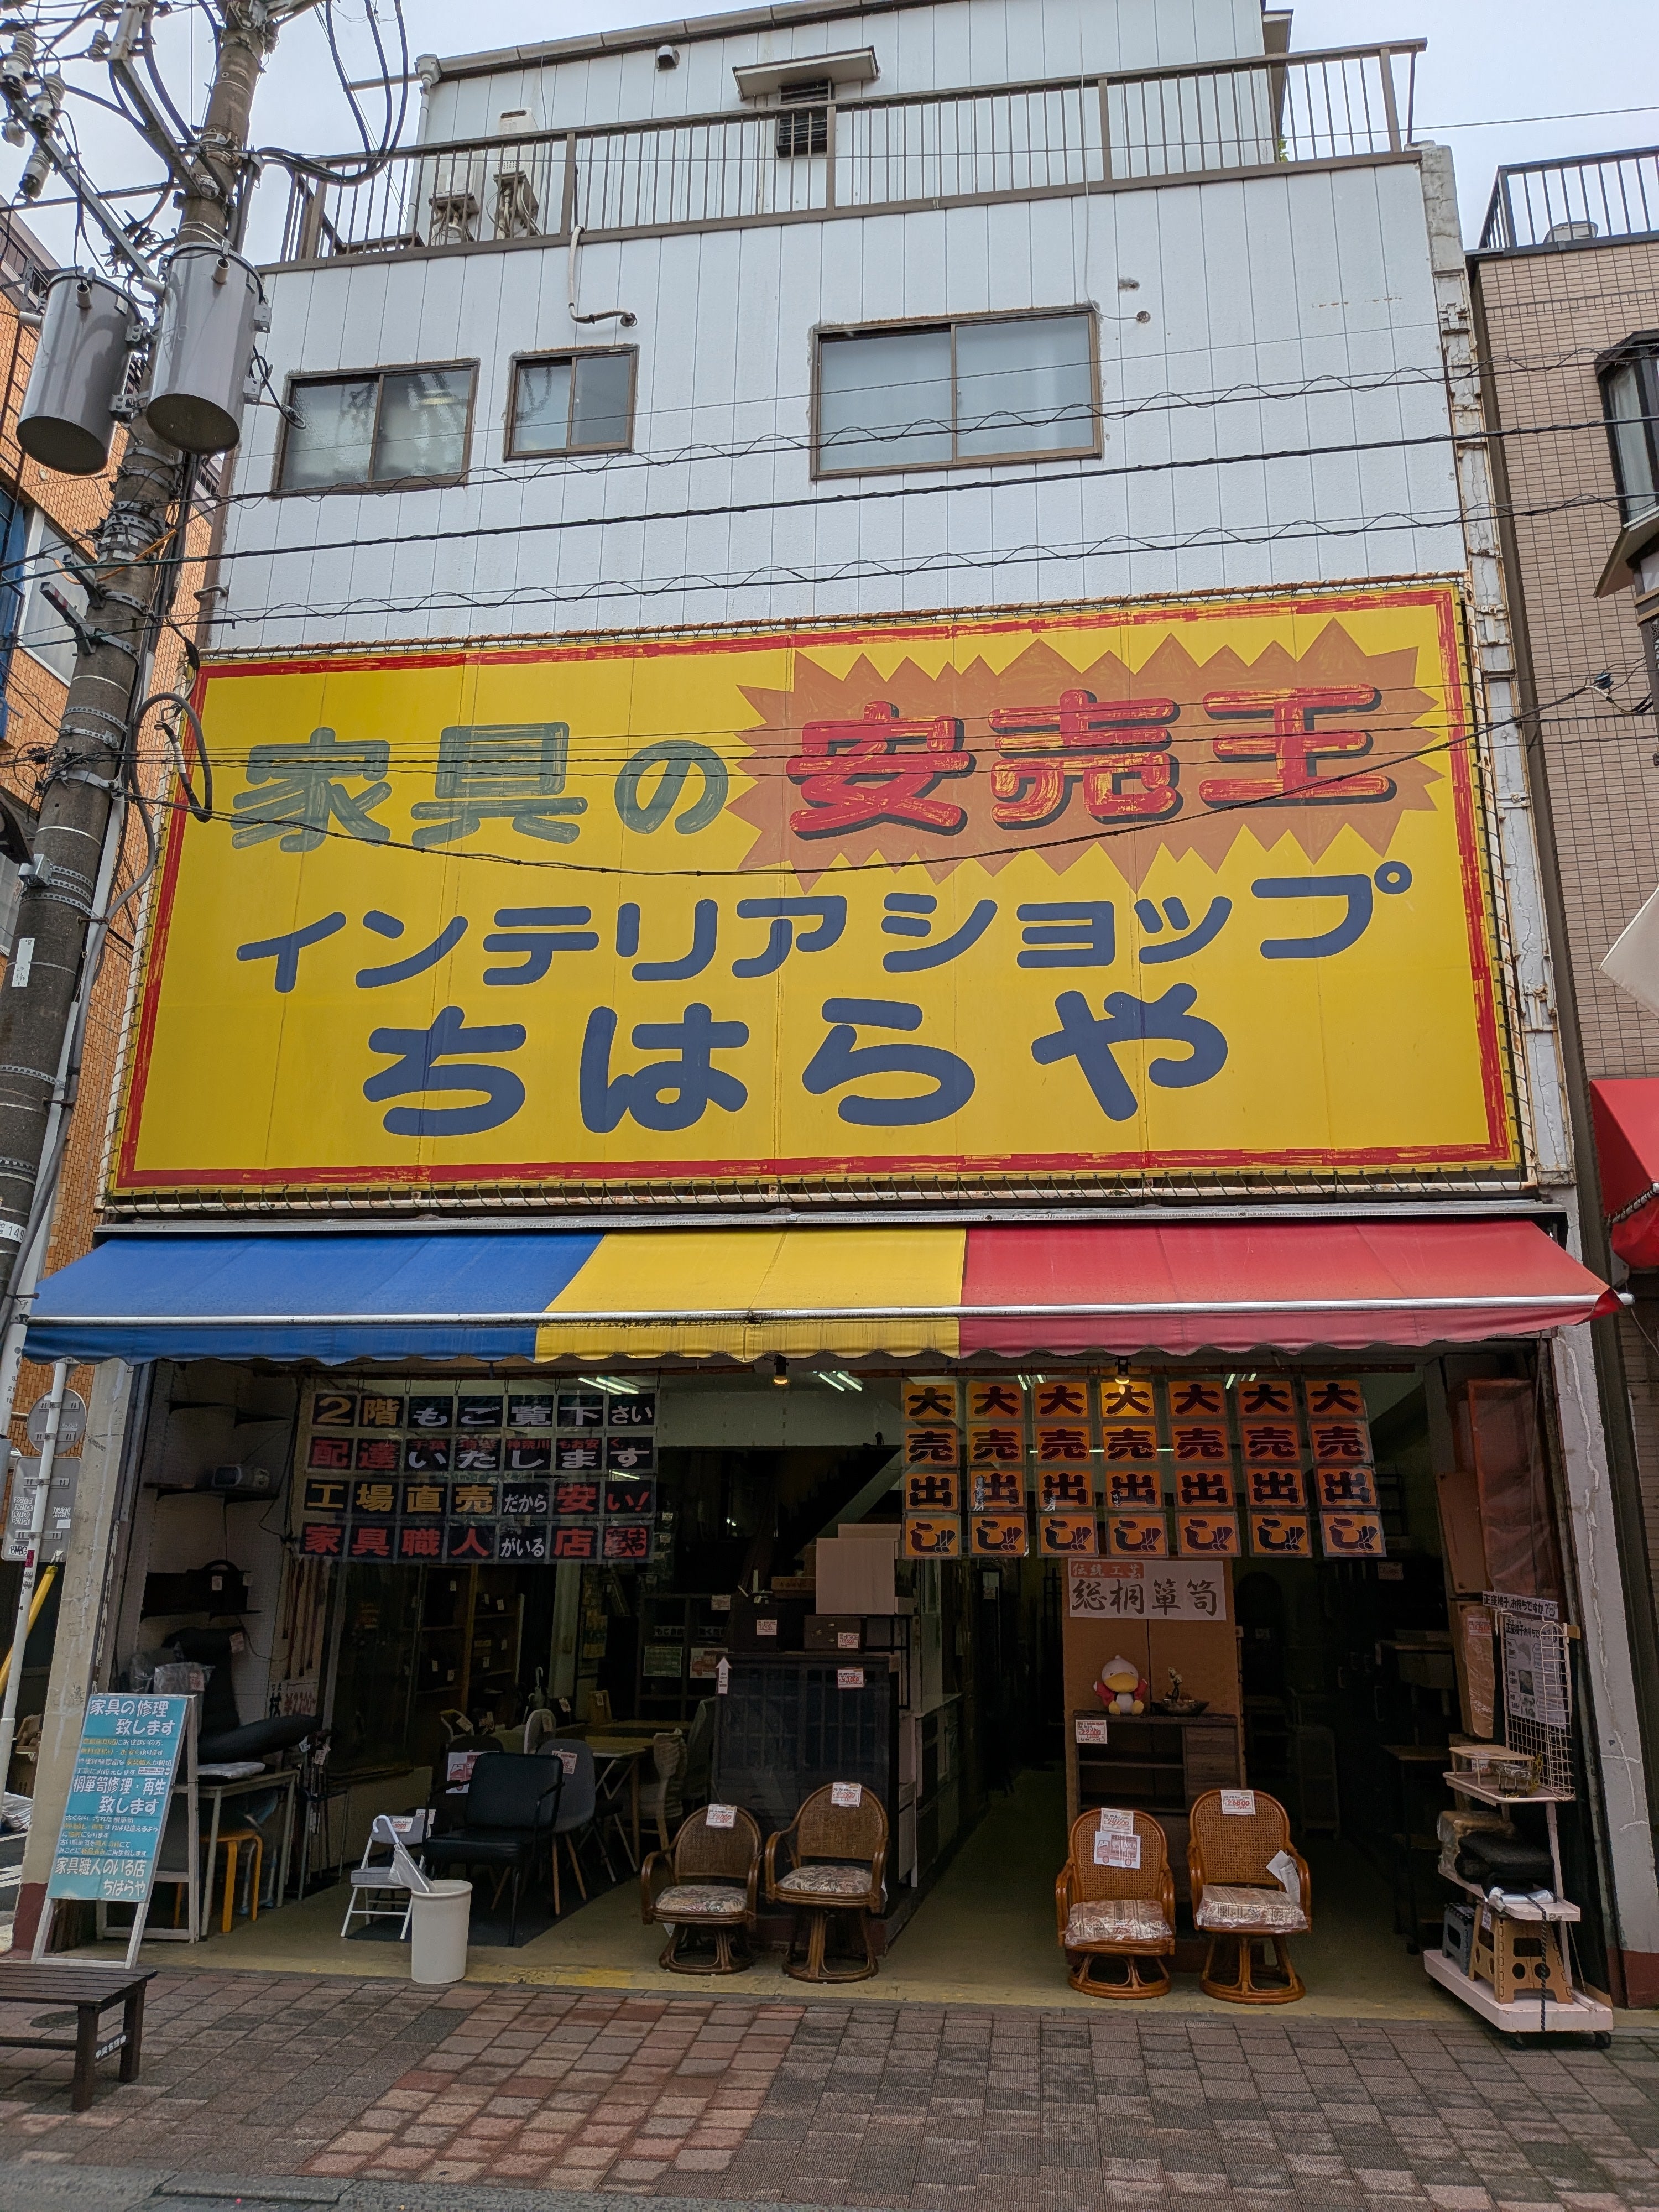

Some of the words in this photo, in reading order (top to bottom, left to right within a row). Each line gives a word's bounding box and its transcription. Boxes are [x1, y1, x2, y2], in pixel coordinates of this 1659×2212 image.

[236, 860, 1412, 993] インテリアショップ
[363, 983, 1228, 1136] ちはらや
[319, 1397, 653, 1426] 2階もご覧下さい
[310, 1440, 650, 1470] 配達いたします
[1073, 1563, 1141, 1578] 伝統工芸
[1071, 1578, 1219, 1616] 総桐箪笥
[89, 1698, 169, 1718] 家具の修理
[115, 1718, 176, 1736] 致します
[98, 1796, 160, 1815] 致します
[55, 1858, 147, 1877] 家具職人のいる店
[103, 1880, 146, 1897] ちはらや
